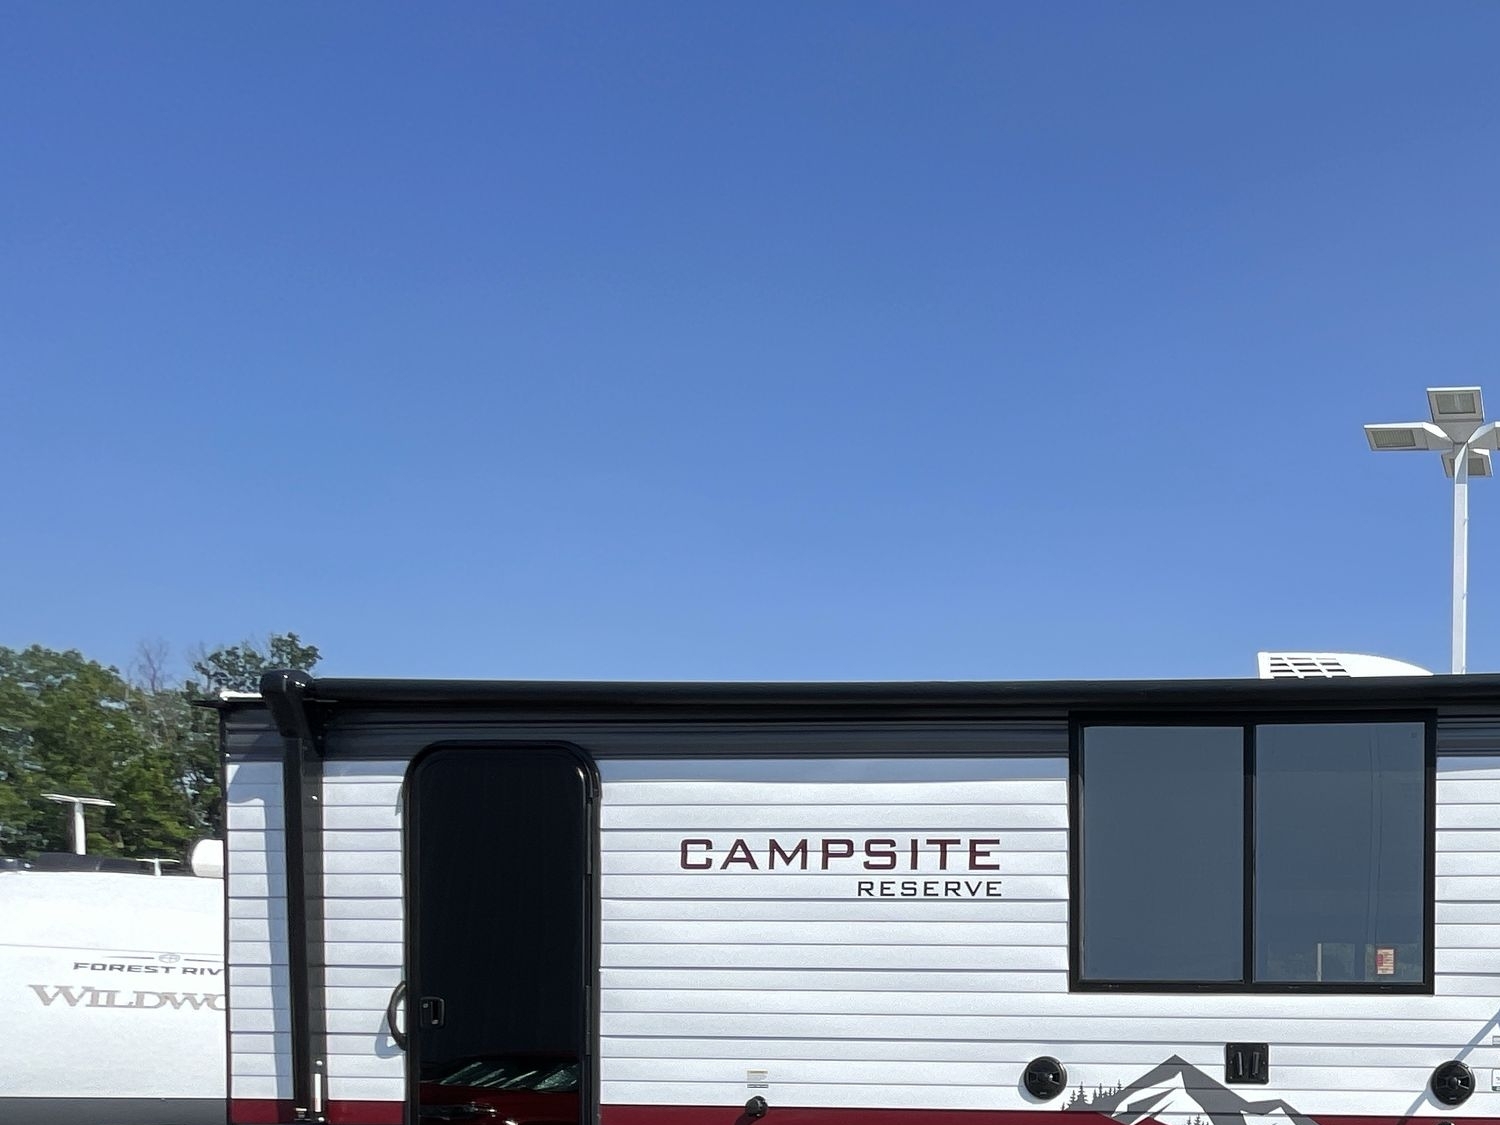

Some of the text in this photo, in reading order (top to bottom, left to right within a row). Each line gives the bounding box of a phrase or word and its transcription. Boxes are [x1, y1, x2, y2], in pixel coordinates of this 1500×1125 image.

[680, 838, 1001, 871] CAMPSITE
[857, 880, 1003, 897] RESERVE
[73, 962, 177, 974] FOREST
